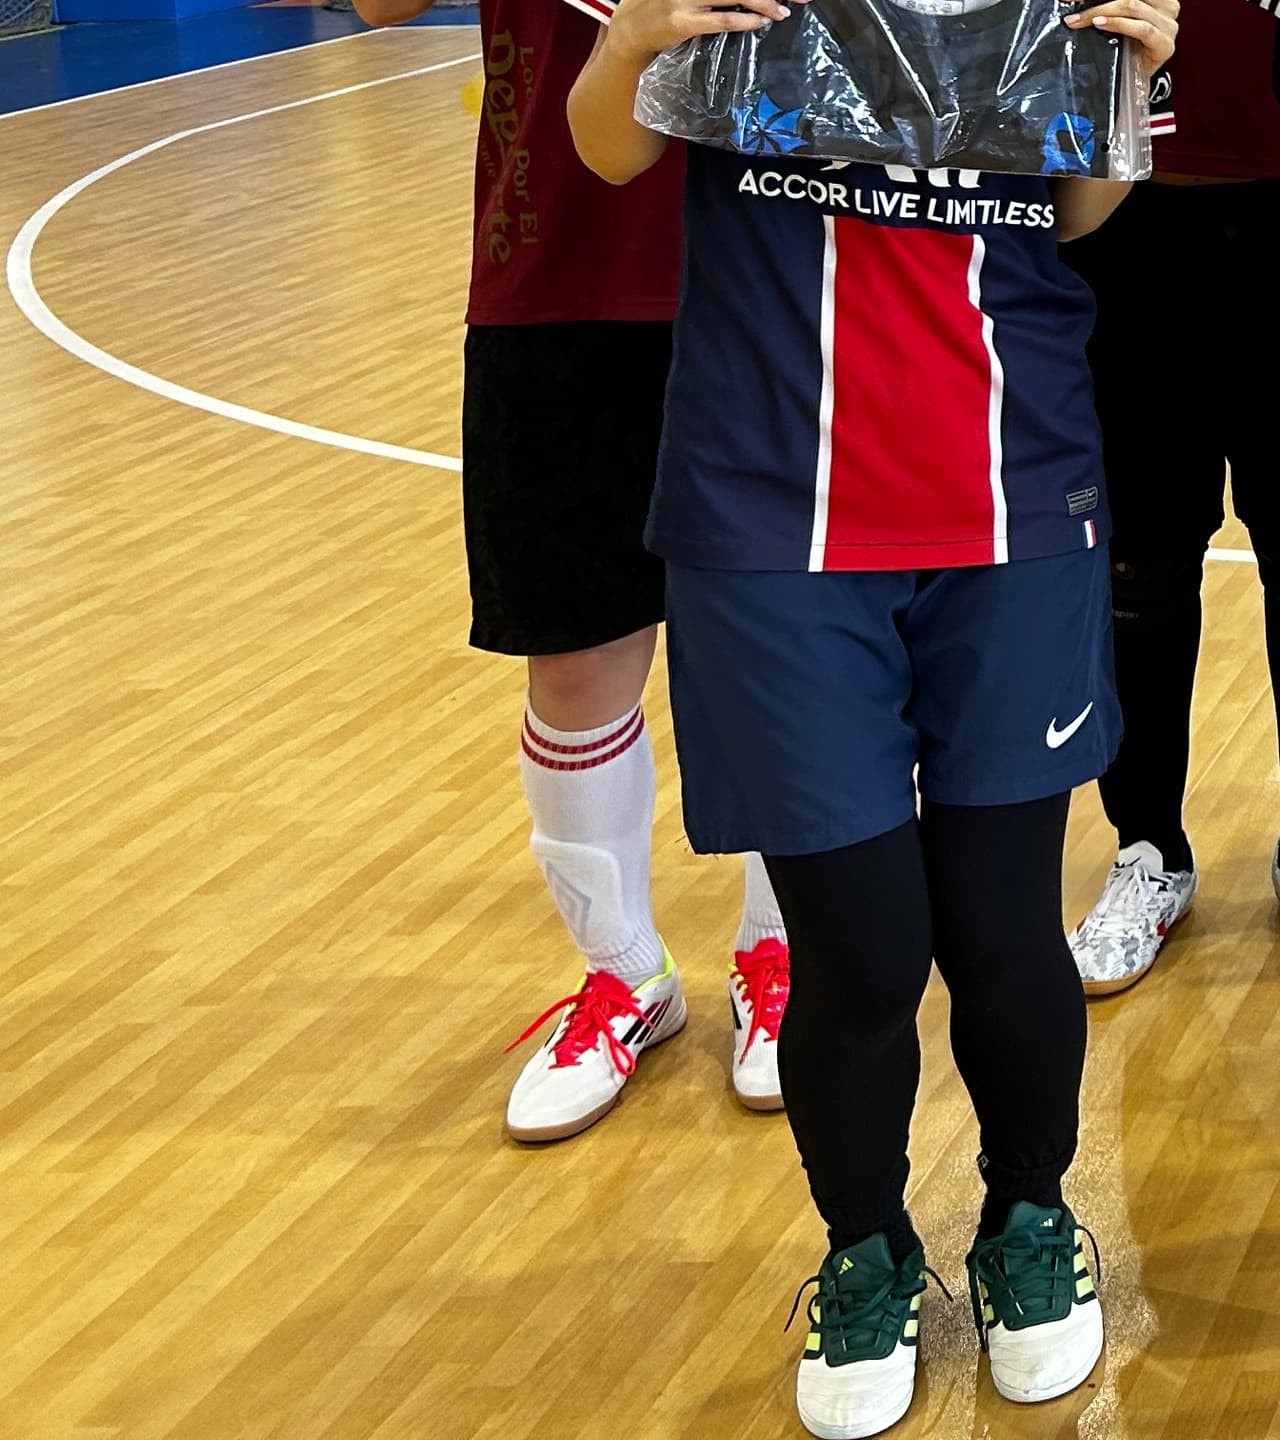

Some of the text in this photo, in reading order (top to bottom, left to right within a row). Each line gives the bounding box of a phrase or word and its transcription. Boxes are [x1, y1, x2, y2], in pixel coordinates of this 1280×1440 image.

[737, 167, 849, 208] ACCOR
[855, 189, 920, 220] LIVE
[926, 196, 1055, 229] LIMITLESS
